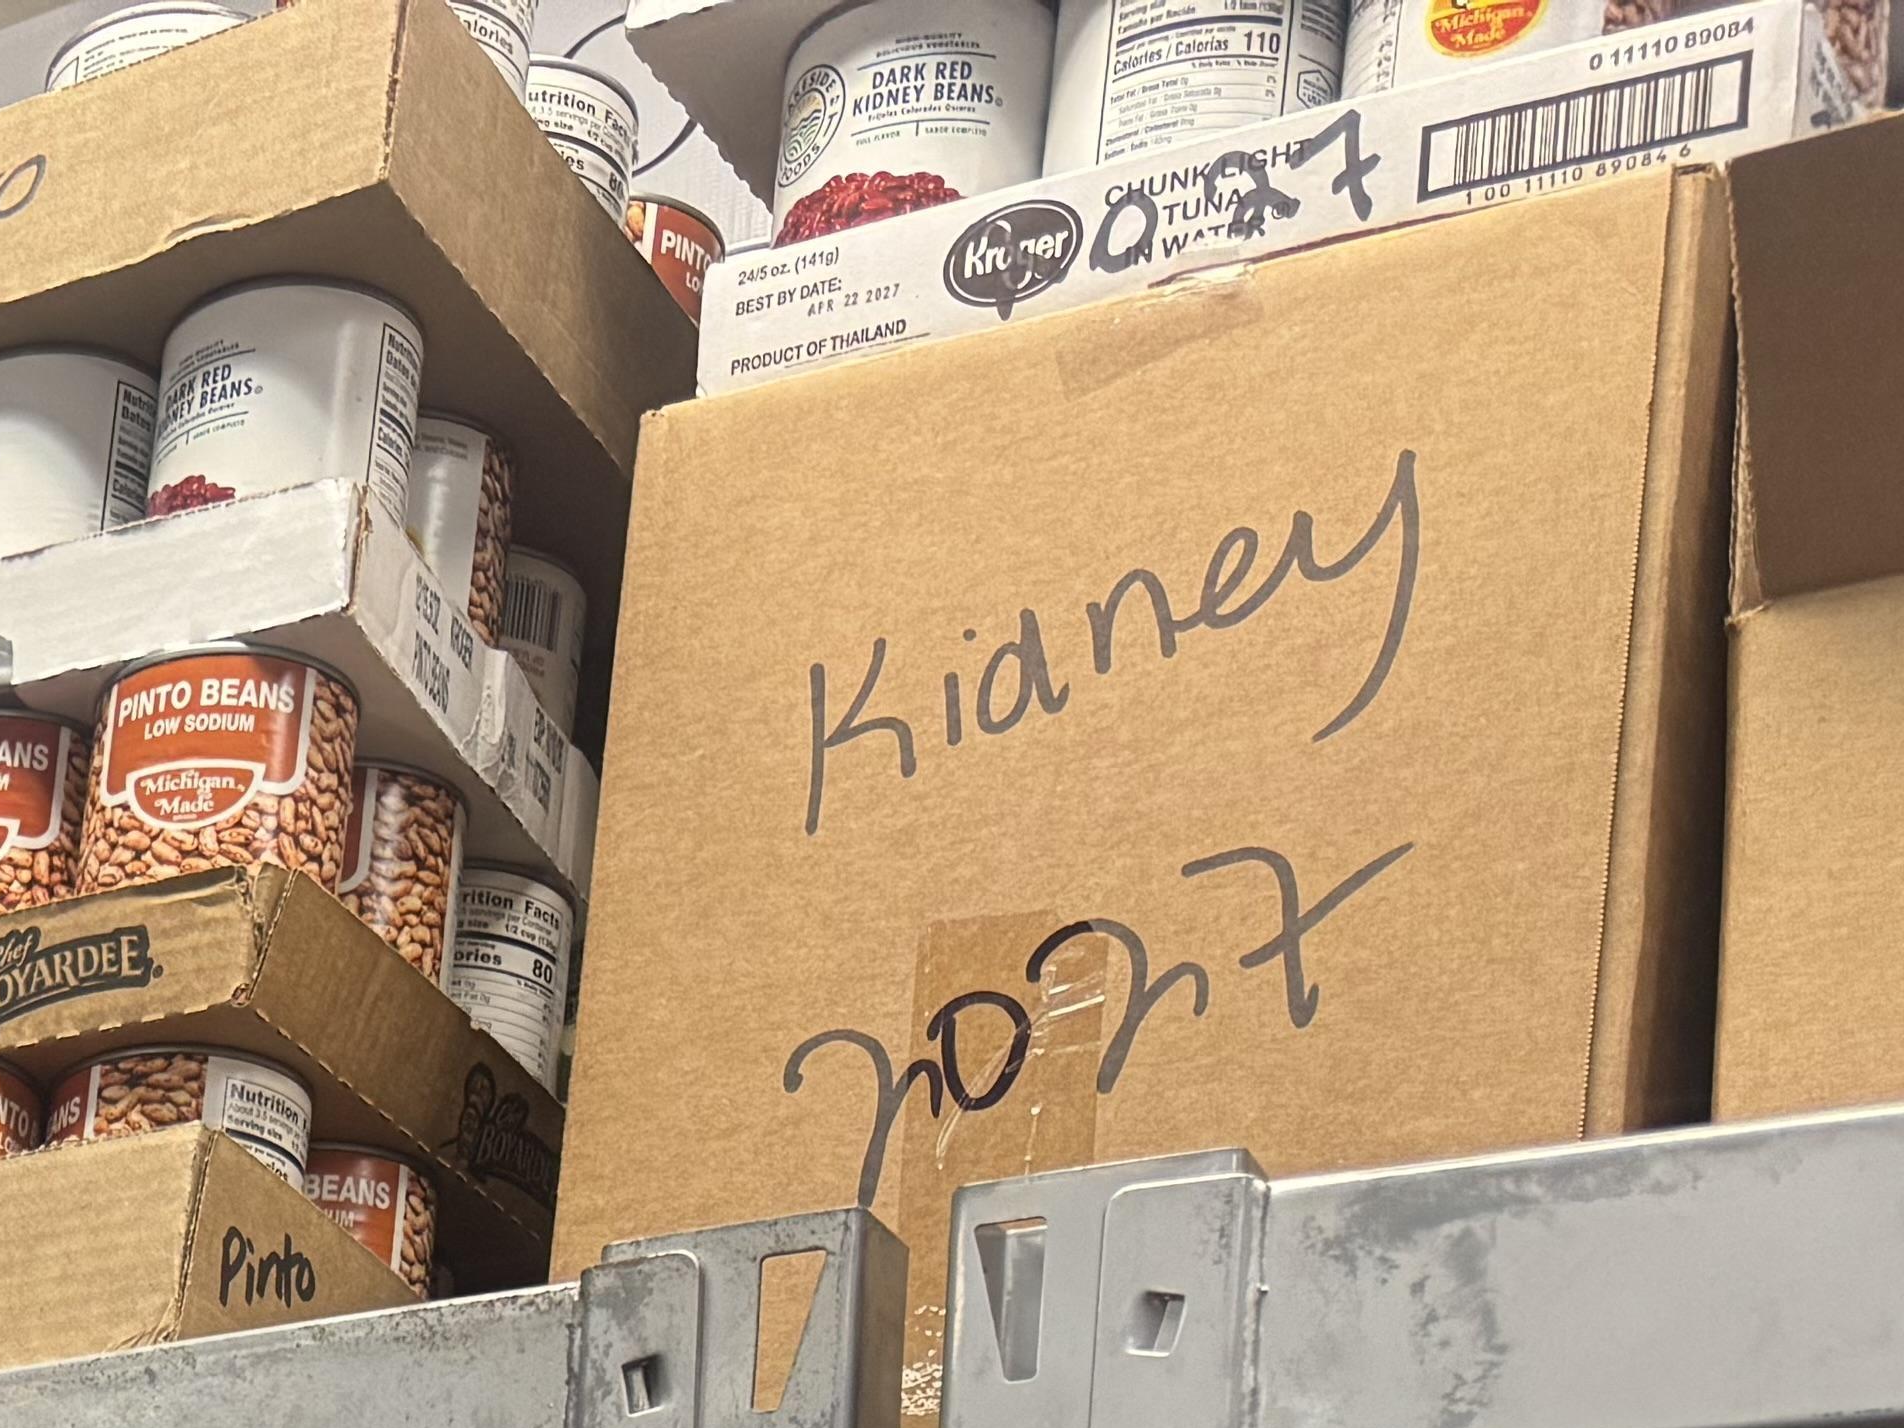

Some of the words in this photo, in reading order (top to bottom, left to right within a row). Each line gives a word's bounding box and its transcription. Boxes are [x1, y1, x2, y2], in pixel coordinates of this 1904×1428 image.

[1113, 47, 1162, 76] Calories
[1243, 31, 1281, 54] 110
[872, 62, 926, 88] DARK
[935, 61, 972, 82] RED
[853, 84, 928, 117] KIDNEY
[934, 82, 995, 105] BEANS
[738, 264, 770, 287] 24/5
[794, 246, 841, 277] (141g)
[736, 293, 773, 317] BEST
[777, 288, 796, 307] BY
[800, 277, 842, 303] DATE:
[808, 298, 838, 317] APR
[844, 293, 860, 309] 22
[865, 283, 900, 305] 2027
[731, 344, 804, 376] PRODUCT
[806, 339, 828, 358] OF
[830, 318, 908, 353] THAILAND
[805, 449, 1420, 836] Kidney
[117, 680, 192, 727] PINTO
[199, 676, 297, 714] BEANS
[143, 714, 179, 740] LOW
[184, 710, 256, 735] SODIUM
[140, 767, 239, 795] Michigan
[157, 791, 215, 817] Made
[783, 841, 1414, 1207] 2027
